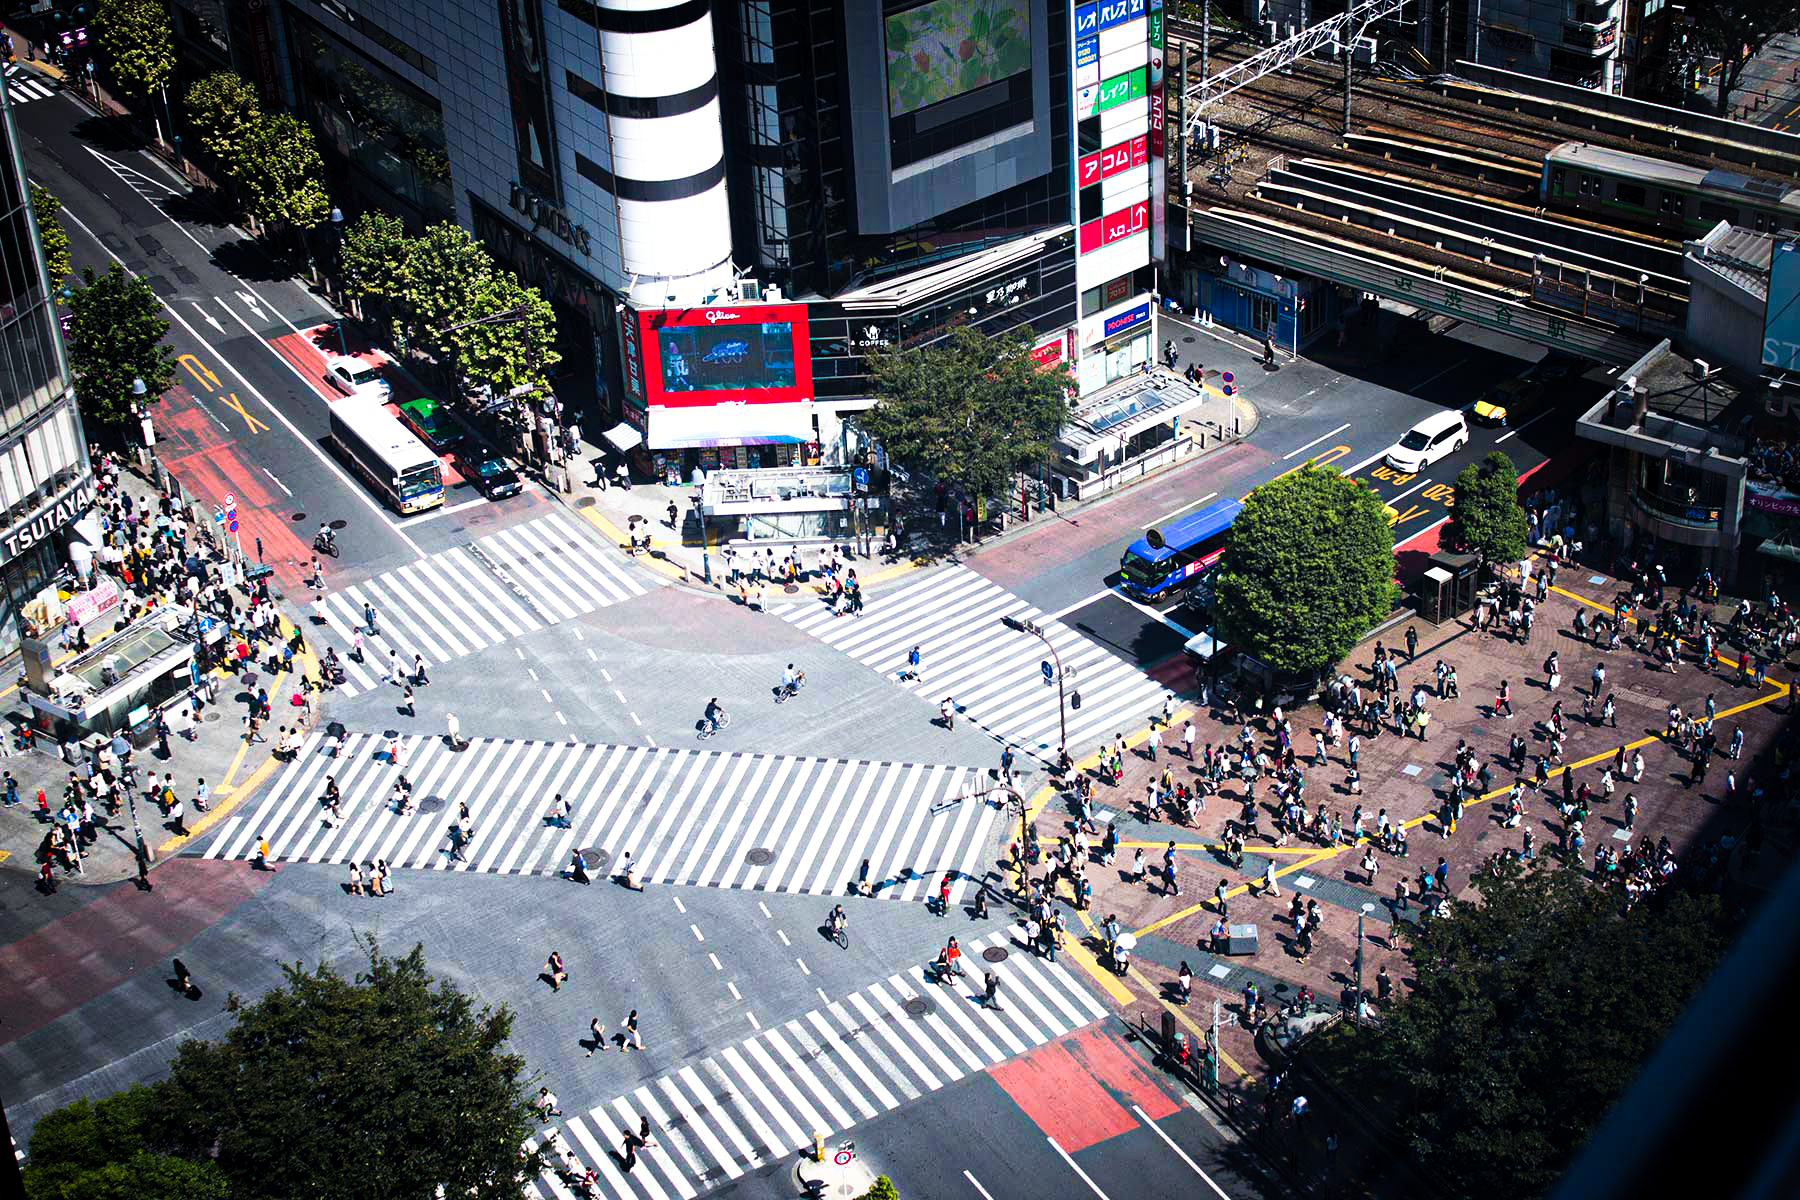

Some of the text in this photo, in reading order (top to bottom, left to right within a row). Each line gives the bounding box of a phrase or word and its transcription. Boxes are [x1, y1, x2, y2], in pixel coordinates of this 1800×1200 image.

[1153, 16, 1161, 41] レイク
[1100, 81, 1129, 102] レイク
[1153, 96, 1162, 131] アコム
[1085, 150, 1129, 179] アコム
[1109, 223, 1126, 240] 入口
[1394, 276, 1568, 340] JR 渋谷駅
[1107, 314, 1135, 331] PROMISE
[858, 339, 889, 347] COFFEE
[5, 487, 89, 558] TSUTAYA
